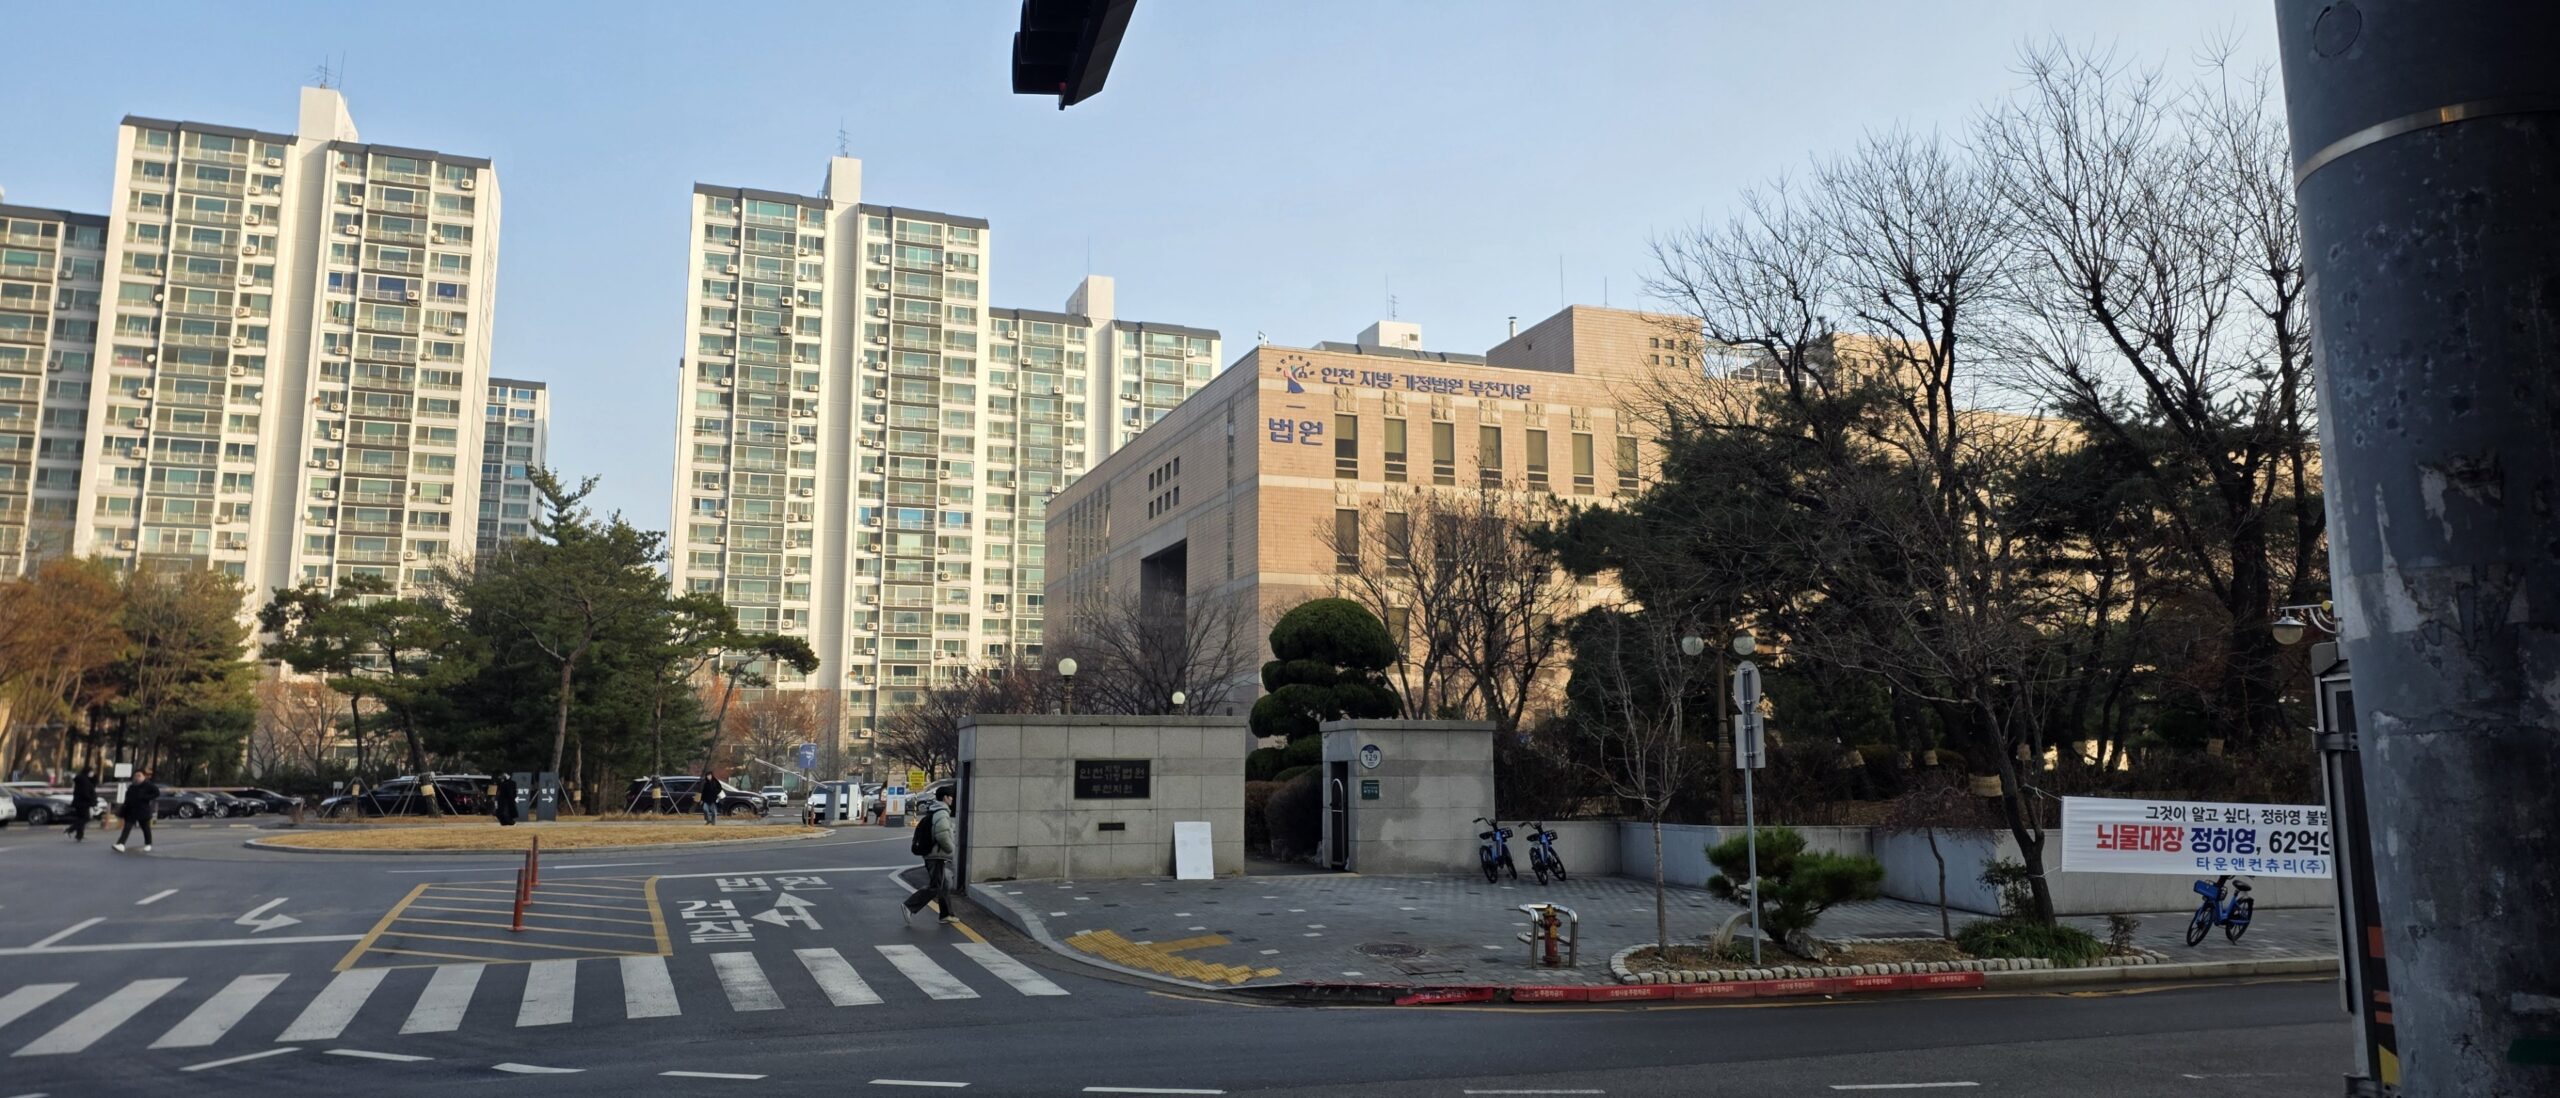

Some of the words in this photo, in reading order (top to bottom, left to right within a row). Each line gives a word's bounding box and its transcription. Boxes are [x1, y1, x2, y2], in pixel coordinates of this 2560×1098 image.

[1321, 366, 1356, 386] 인천
[1468, 380, 1532, 401] 부천지원
[1268, 417, 1324, 446] 법원
[1364, 754, 1378, 762] 129
[2145, 806, 2187, 822] 그것이
[2192, 807, 2218, 822] 알고
[2224, 809, 2256, 825] 싶다,
[2261, 810, 2301, 825] 정하영
[2096, 824, 2184, 853] 뇌물대장
[2190, 827, 2262, 856] 정하영,
[715, 876, 834, 893] 법원
[676, 899, 757, 944] 검찰
